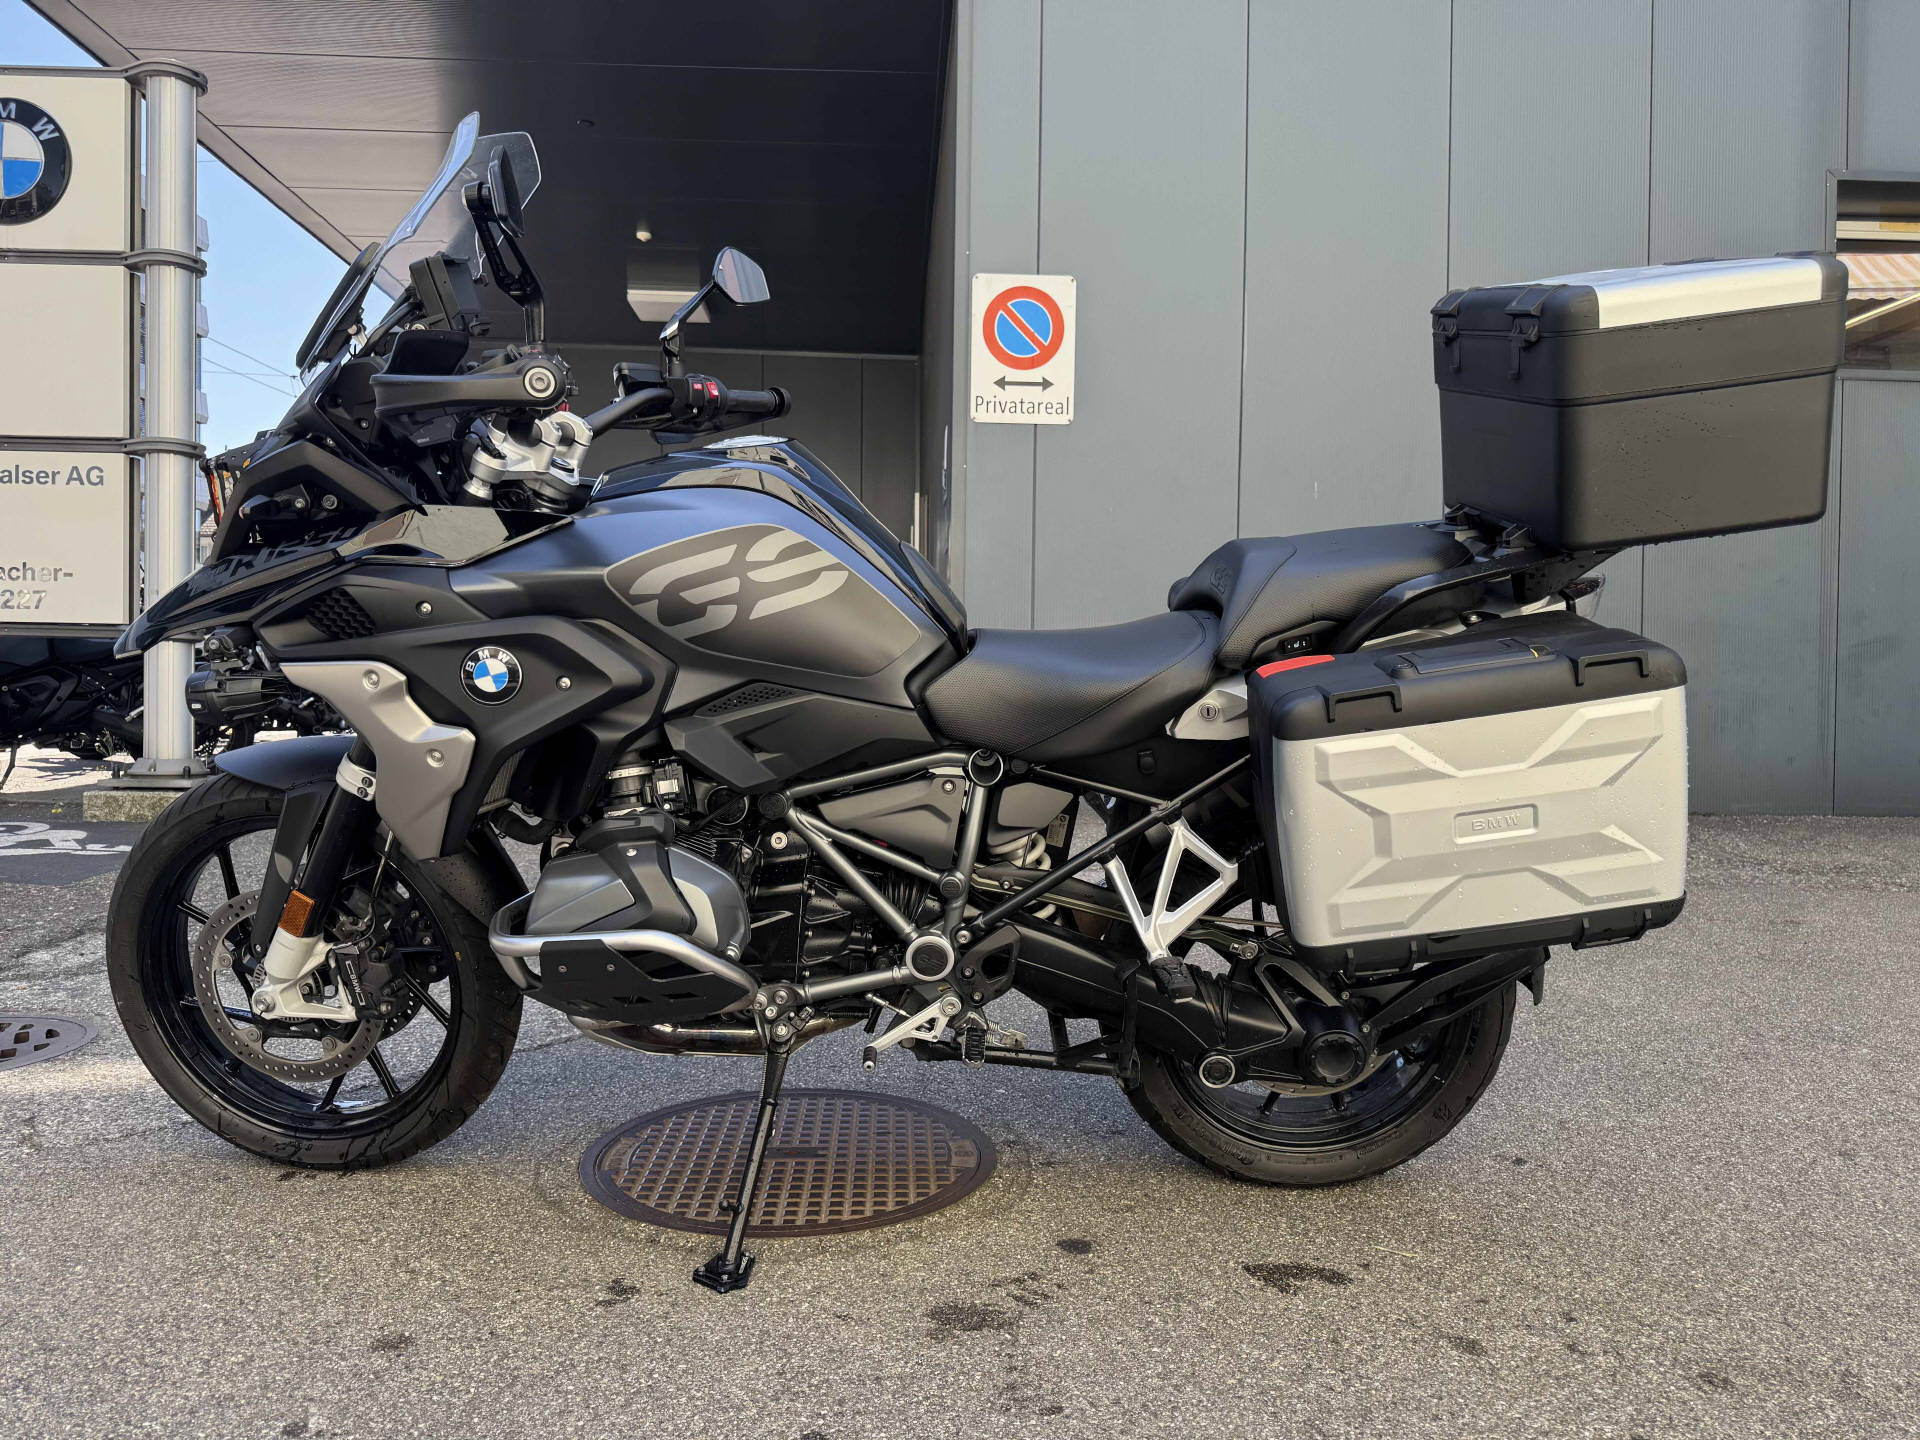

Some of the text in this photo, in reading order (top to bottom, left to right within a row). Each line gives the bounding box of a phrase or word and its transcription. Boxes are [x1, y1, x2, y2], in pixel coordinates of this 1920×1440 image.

[975, 394, 1070, 415] Privatareal
[65, 465, 104, 486] AG
[0, 589, 47, 610] 227
[465, 648, 511, 672] BMW
[1471, 813, 1520, 832] BMW
[350, 974, 362, 993] BMW
